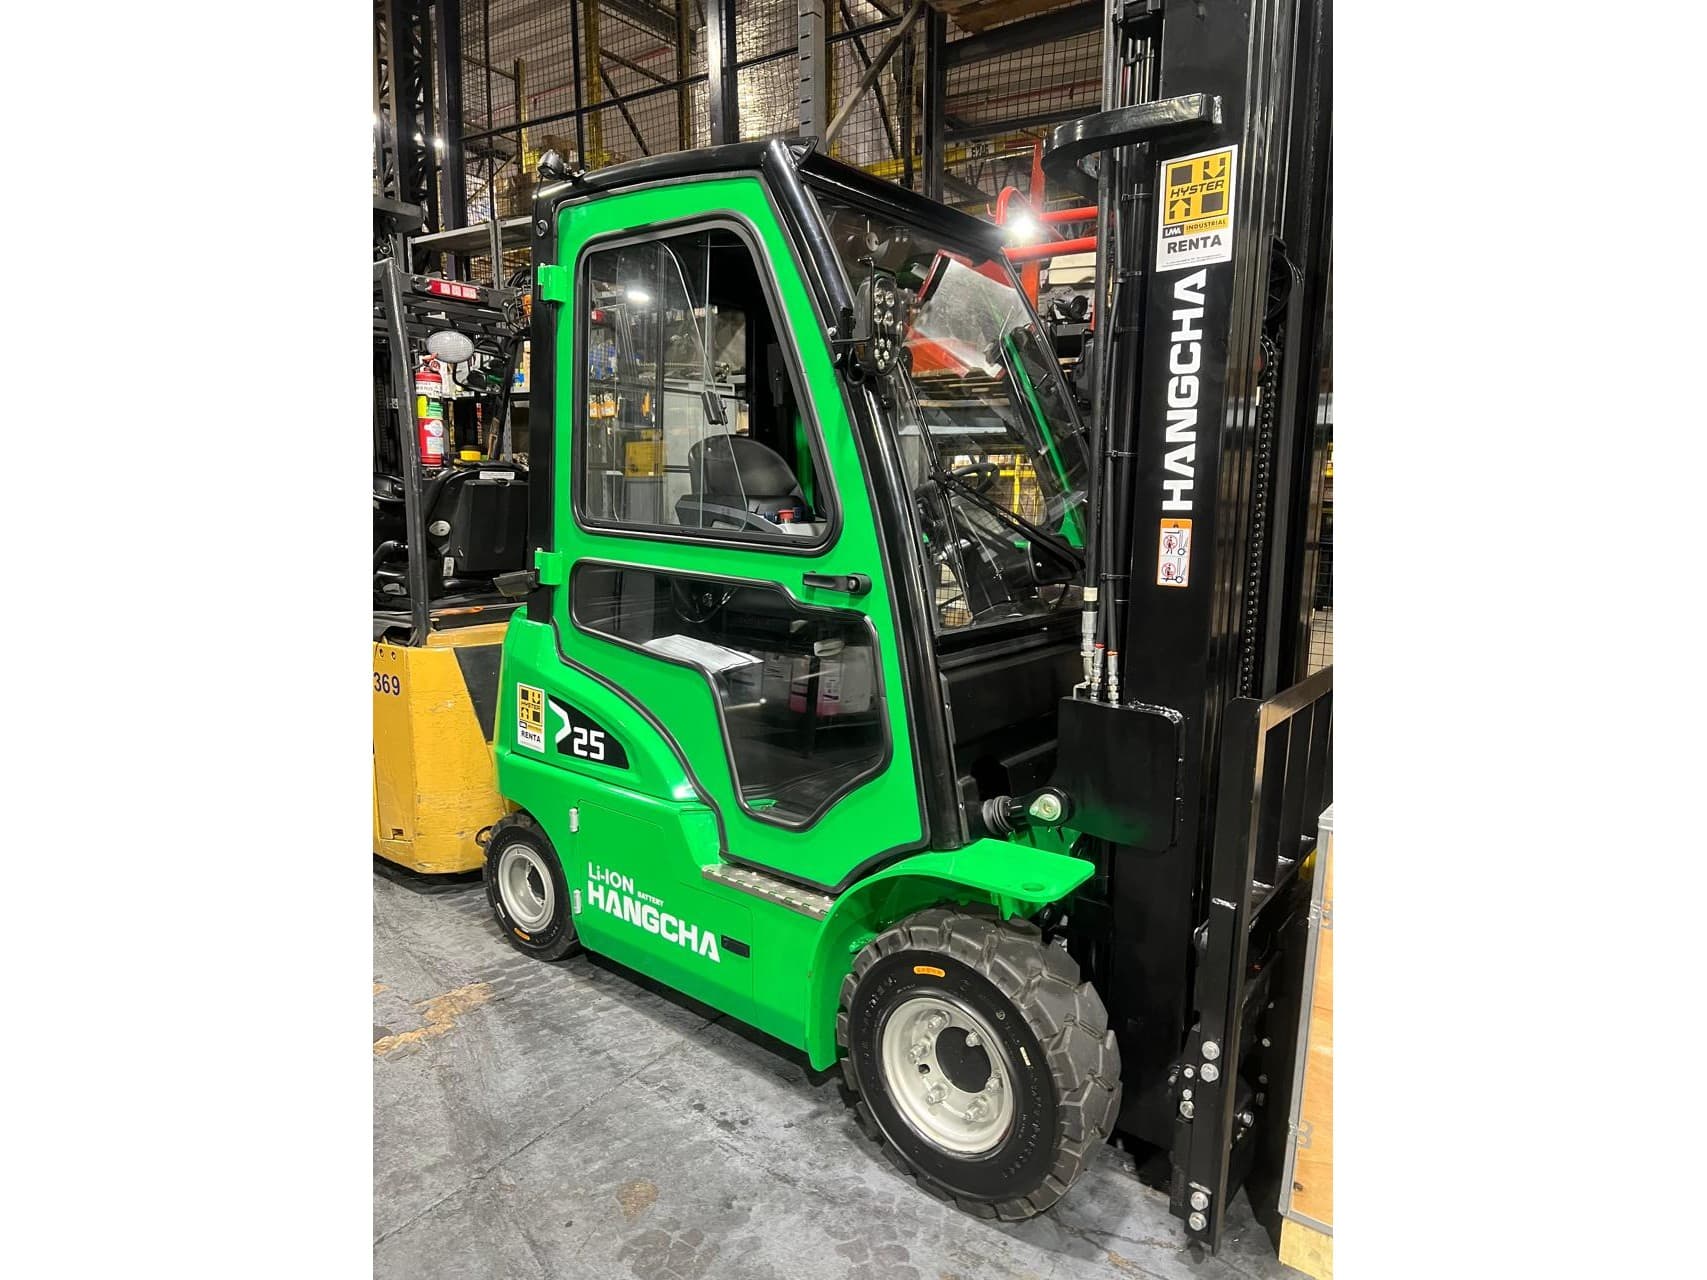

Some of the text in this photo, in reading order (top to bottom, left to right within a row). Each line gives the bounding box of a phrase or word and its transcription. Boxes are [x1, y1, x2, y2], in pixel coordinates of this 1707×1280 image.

[1170, 180, 1225, 198] HYSTER
[1186, 220, 1226, 231] INDUSTRIAL
[1167, 235, 1222, 254] RENTA
[1162, 268, 1207, 511] HANGCHA
[373, 671, 400, 696] 369
[521, 730, 541, 743] RENTA
[573, 726, 605, 761] 25
[588, 861, 634, 895] Li-ION
[588, 880, 720, 963] HANGCHA
